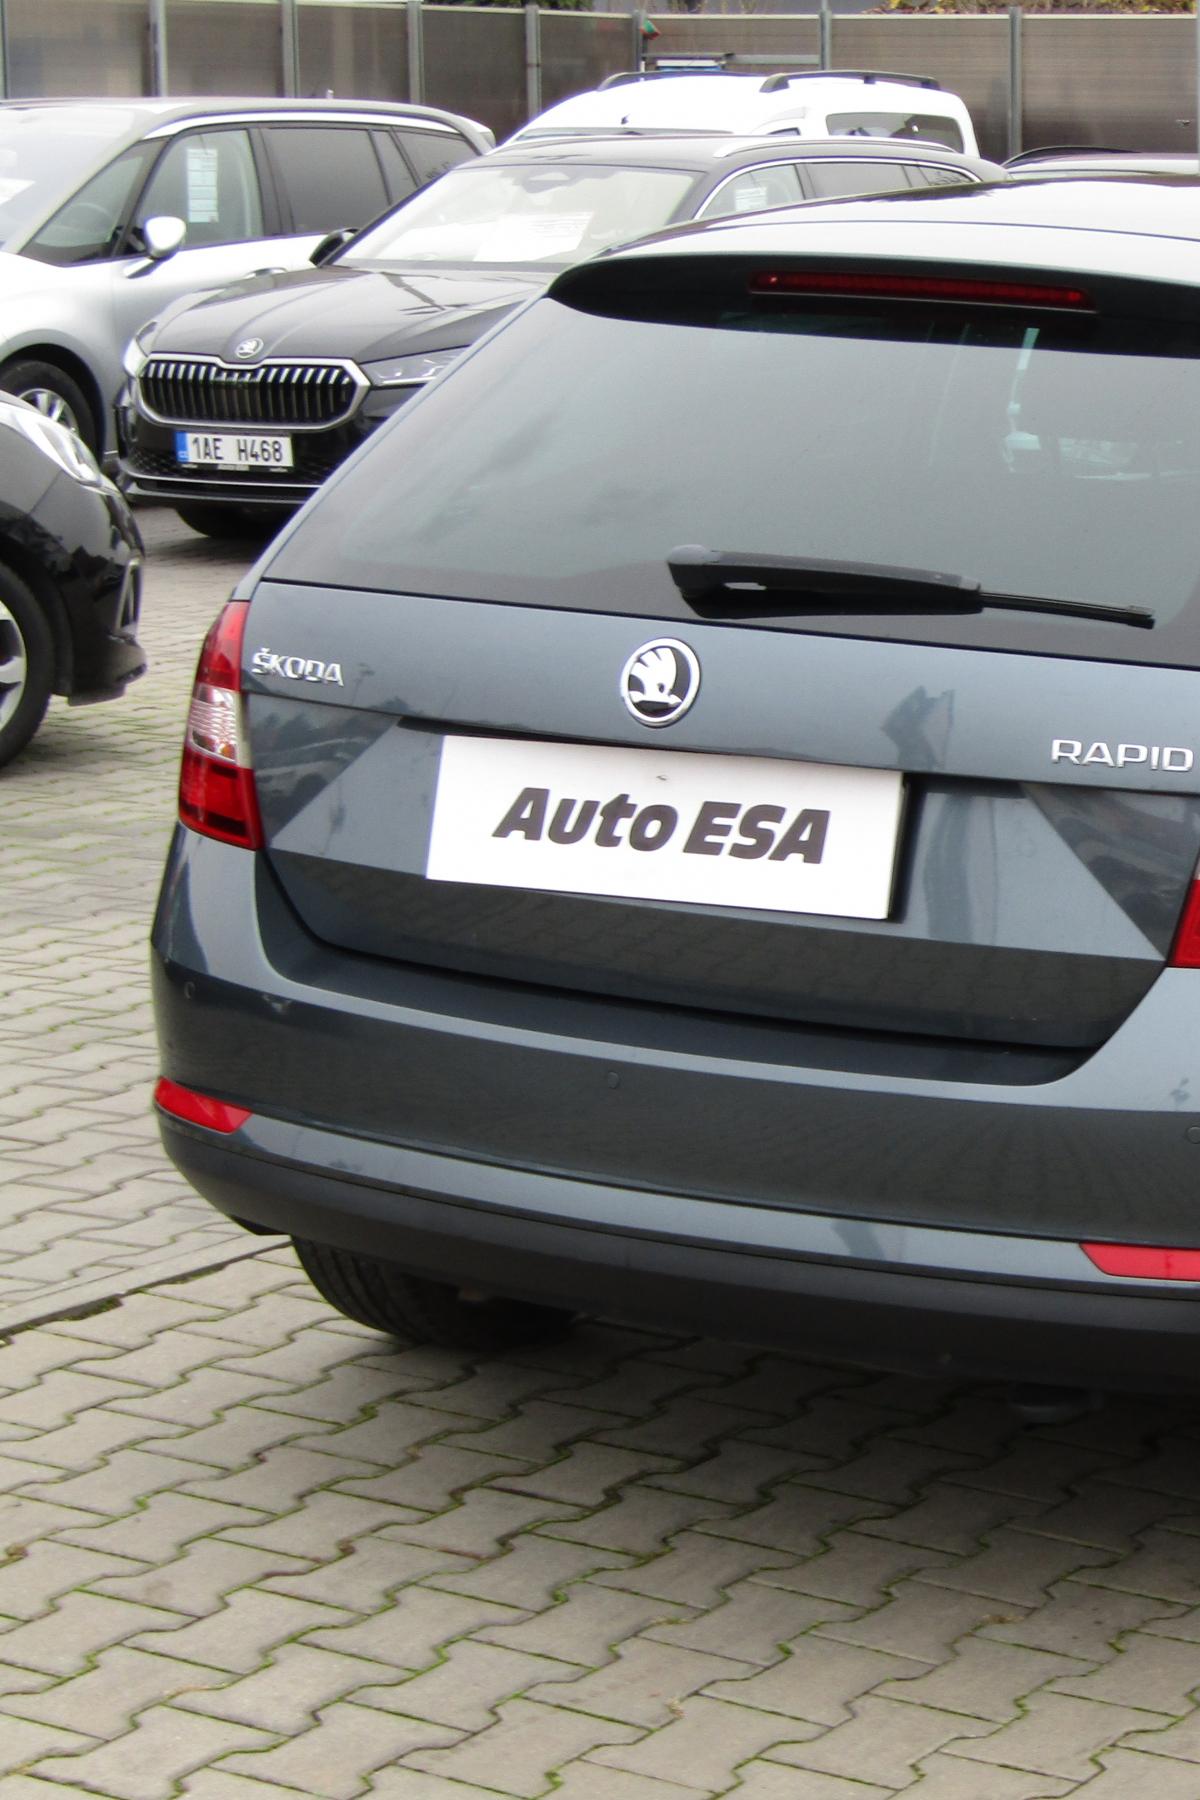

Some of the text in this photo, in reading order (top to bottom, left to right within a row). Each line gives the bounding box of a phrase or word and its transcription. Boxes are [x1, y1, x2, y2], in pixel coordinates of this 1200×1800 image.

[191, 437, 283, 463] 1AE H468
[251, 647, 345, 687] ŠKODA
[1050, 738, 1195, 773] RAPID
[491, 786, 832, 865] Auto ESA
